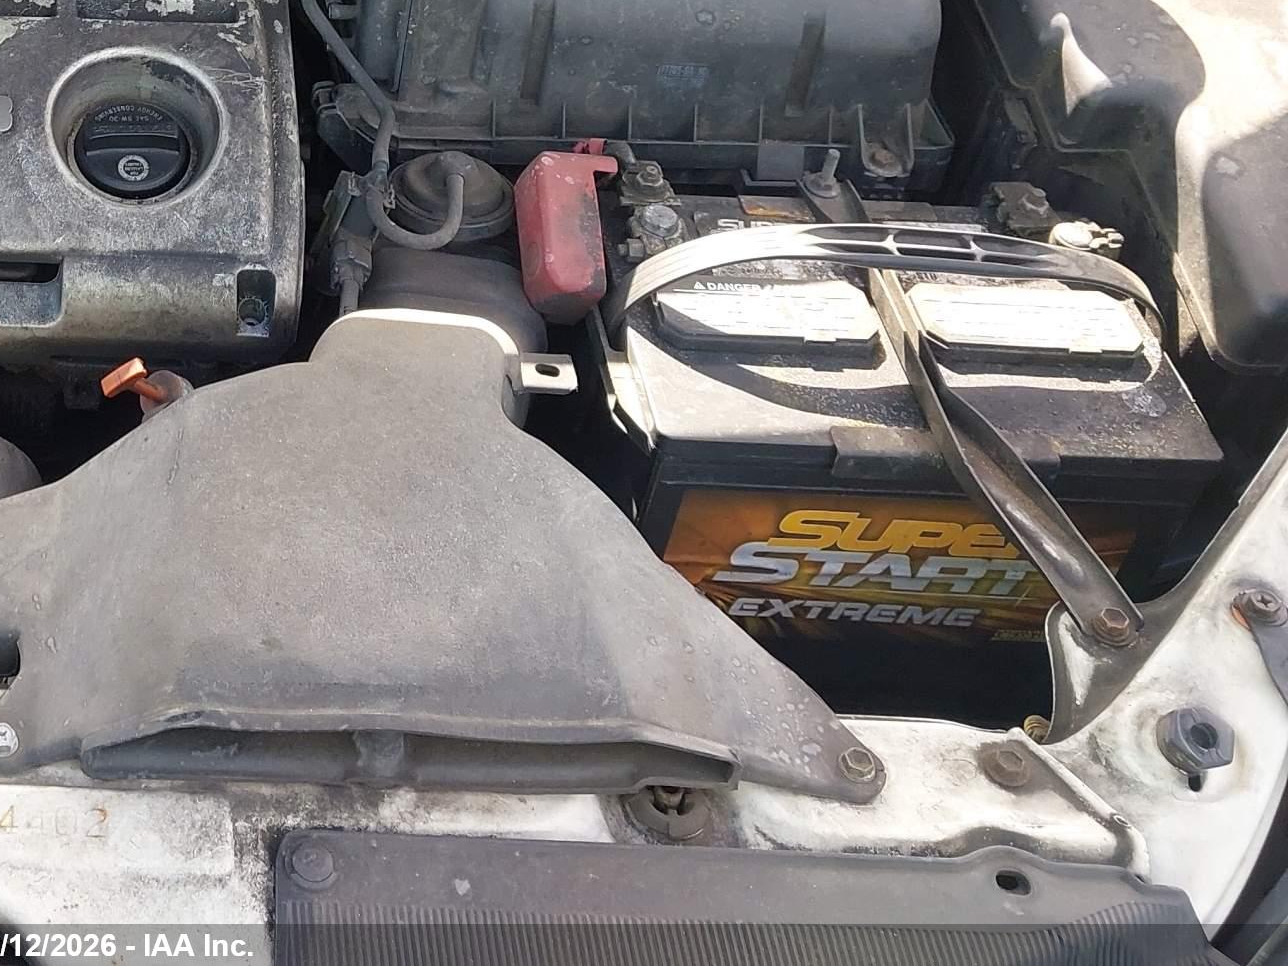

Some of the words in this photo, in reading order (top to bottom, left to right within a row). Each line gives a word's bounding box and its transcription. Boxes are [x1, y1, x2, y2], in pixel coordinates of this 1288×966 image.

[768, 509, 1020, 559] SUPE
[713, 541, 1038, 596] START
[728, 598, 984, 628] EXTREME
